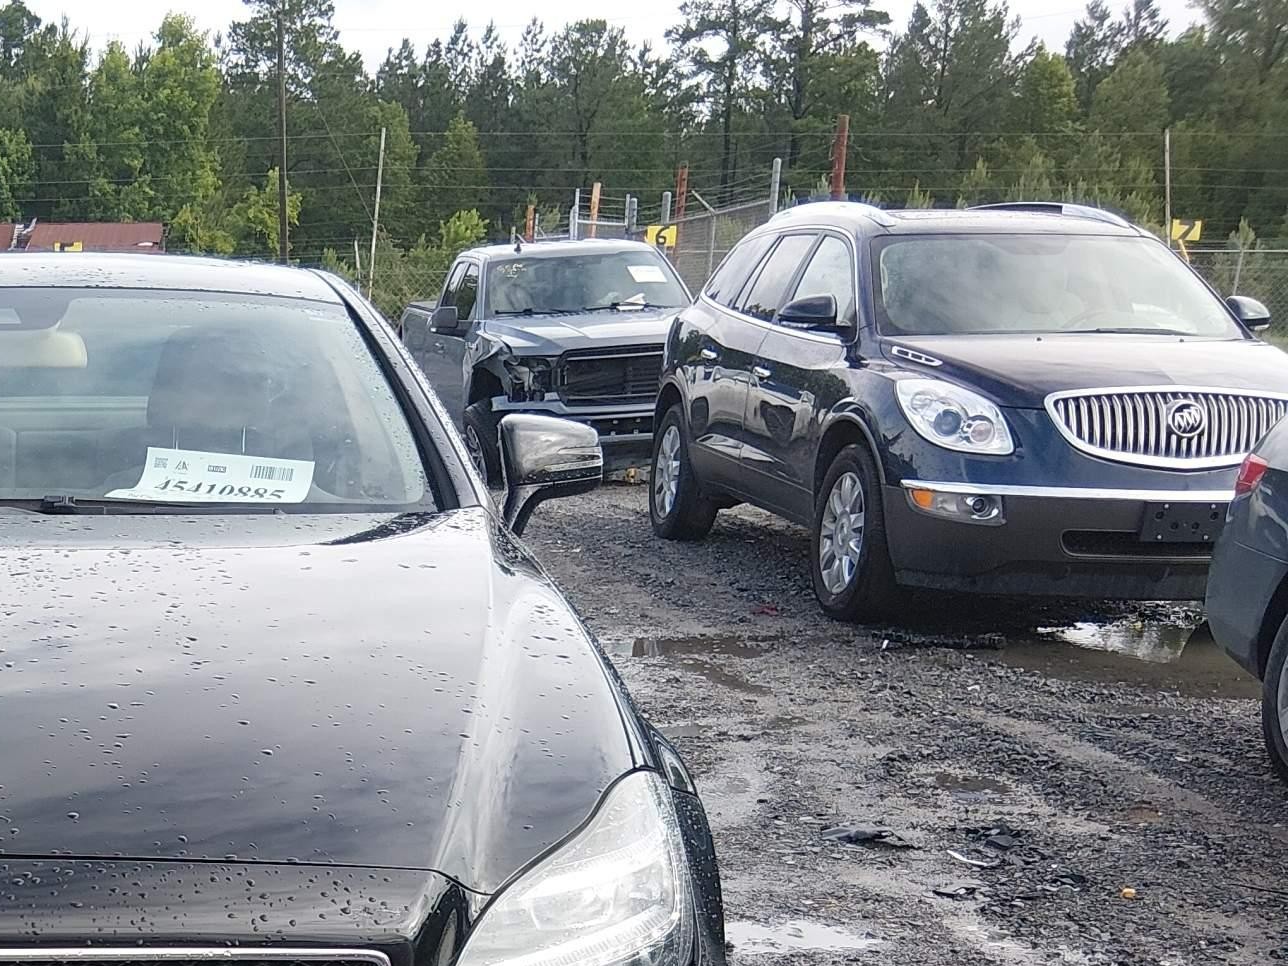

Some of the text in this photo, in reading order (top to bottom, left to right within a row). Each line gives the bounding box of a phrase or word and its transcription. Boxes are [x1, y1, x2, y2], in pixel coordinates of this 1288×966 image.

[656, 224, 671, 245] 6
[1178, 219, 1196, 241] 7
[154, 478, 285, 500] 45410885
